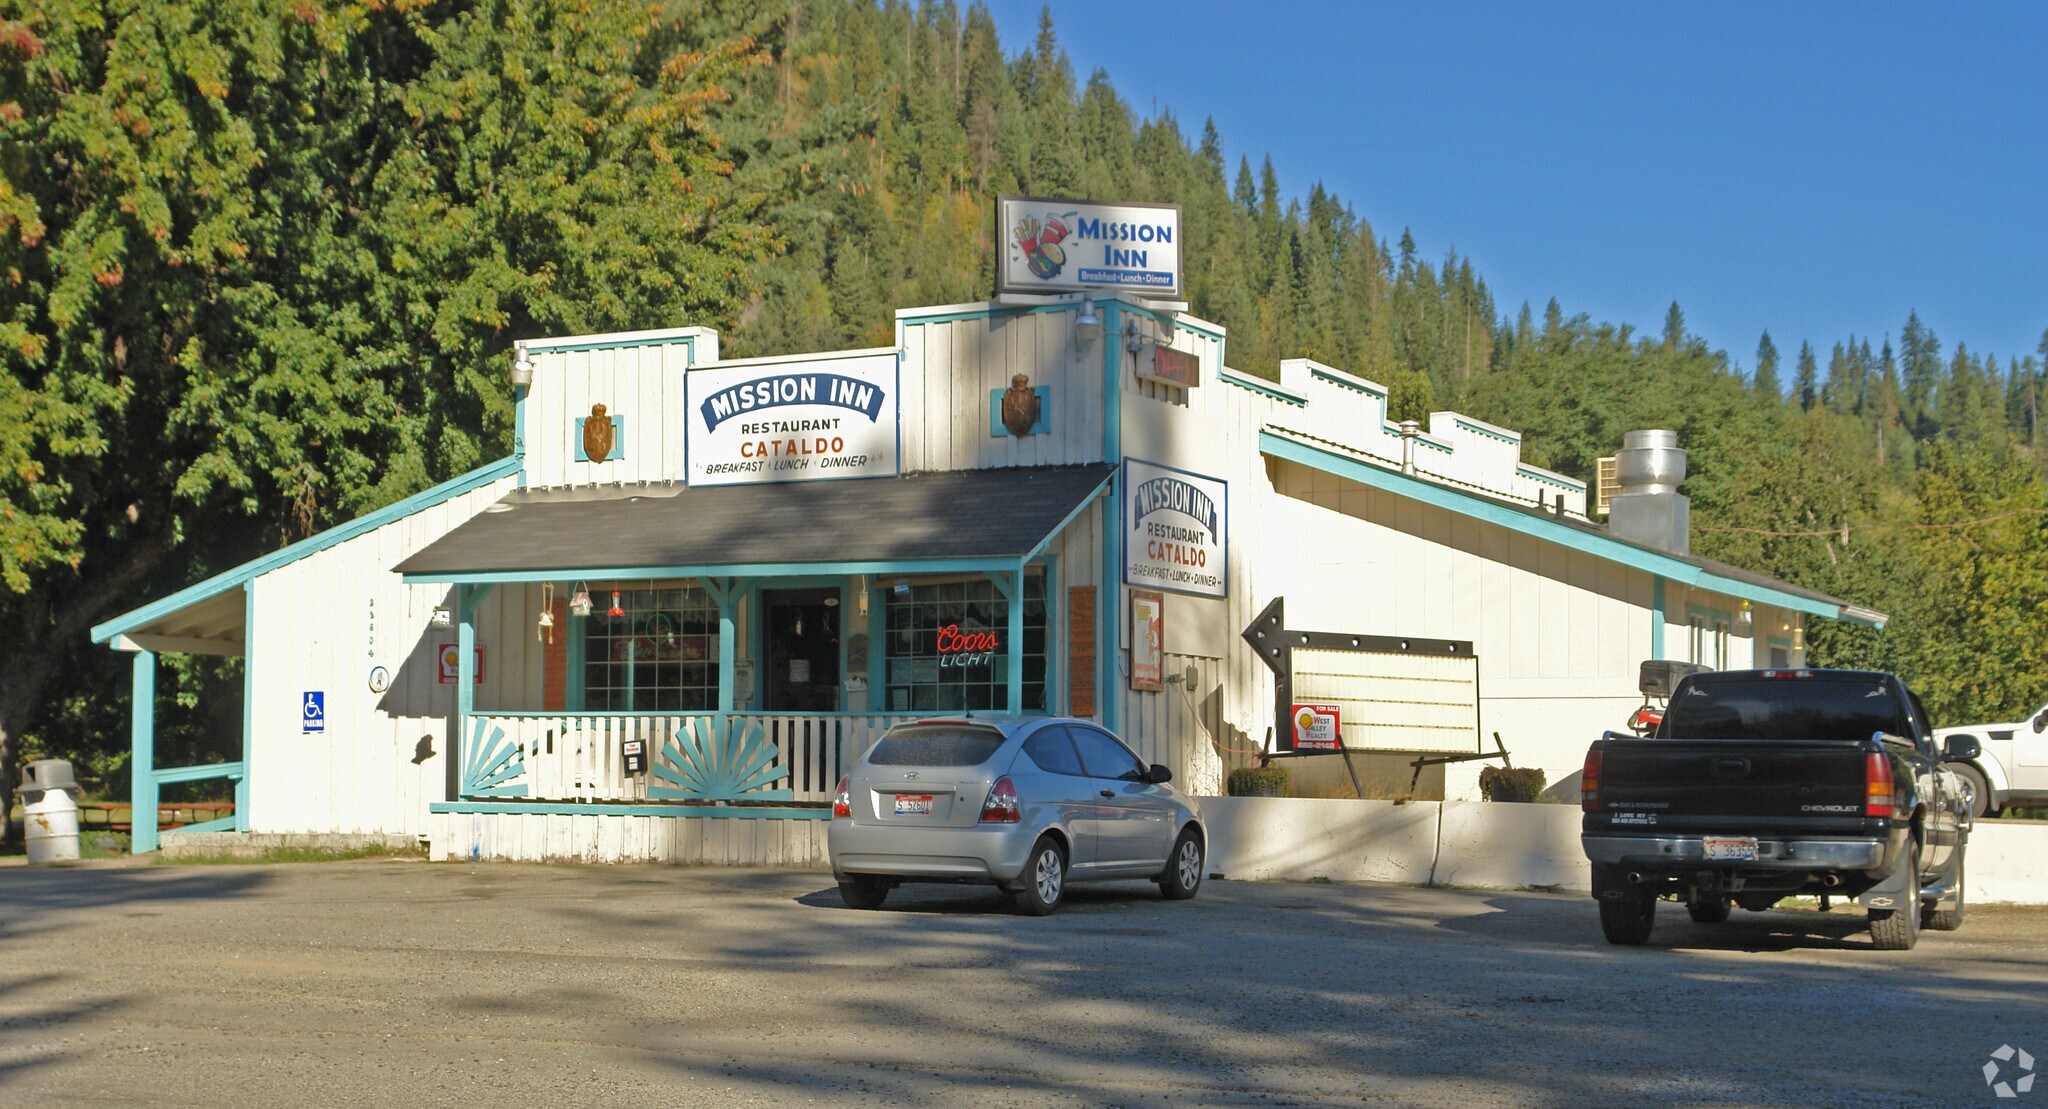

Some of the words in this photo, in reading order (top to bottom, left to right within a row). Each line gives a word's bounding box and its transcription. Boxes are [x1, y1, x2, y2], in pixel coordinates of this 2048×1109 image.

[1078, 217, 1172, 243] MISSION
[1104, 244, 1147, 268] INN
[1081, 271, 1117, 282] Breakfast
[1120, 272, 1142, 283] Lunch
[1146, 273, 1170, 284] Dinner
[1154, 348, 1196, 385] OPEN
[710, 376, 816, 420] MISSION
[830, 378, 874, 411] INN
[741, 418, 840, 435] RESTAURANT
[740, 436, 844, 458] CATALDO
[706, 460, 764, 475] BREAKFAST
[774, 458, 809, 471] LUNCH
[820, 455, 867, 469] DINNER
[1140, 479, 1191, 515] MISSION
[1193, 488, 1212, 527] INN
[1147, 522, 1205, 545] RESTAURANT
[1147, 540, 1206, 568] CATALDO
[1133, 564, 1170, 581] BREAKFAST
[1172, 570, 1191, 583] LUNCH
[1194, 574, 1217, 587] DINNER
[937, 624, 999, 652] Coors
[304, 719, 323, 727] PARKING
[1305, 731, 1327, 739] REALTY
